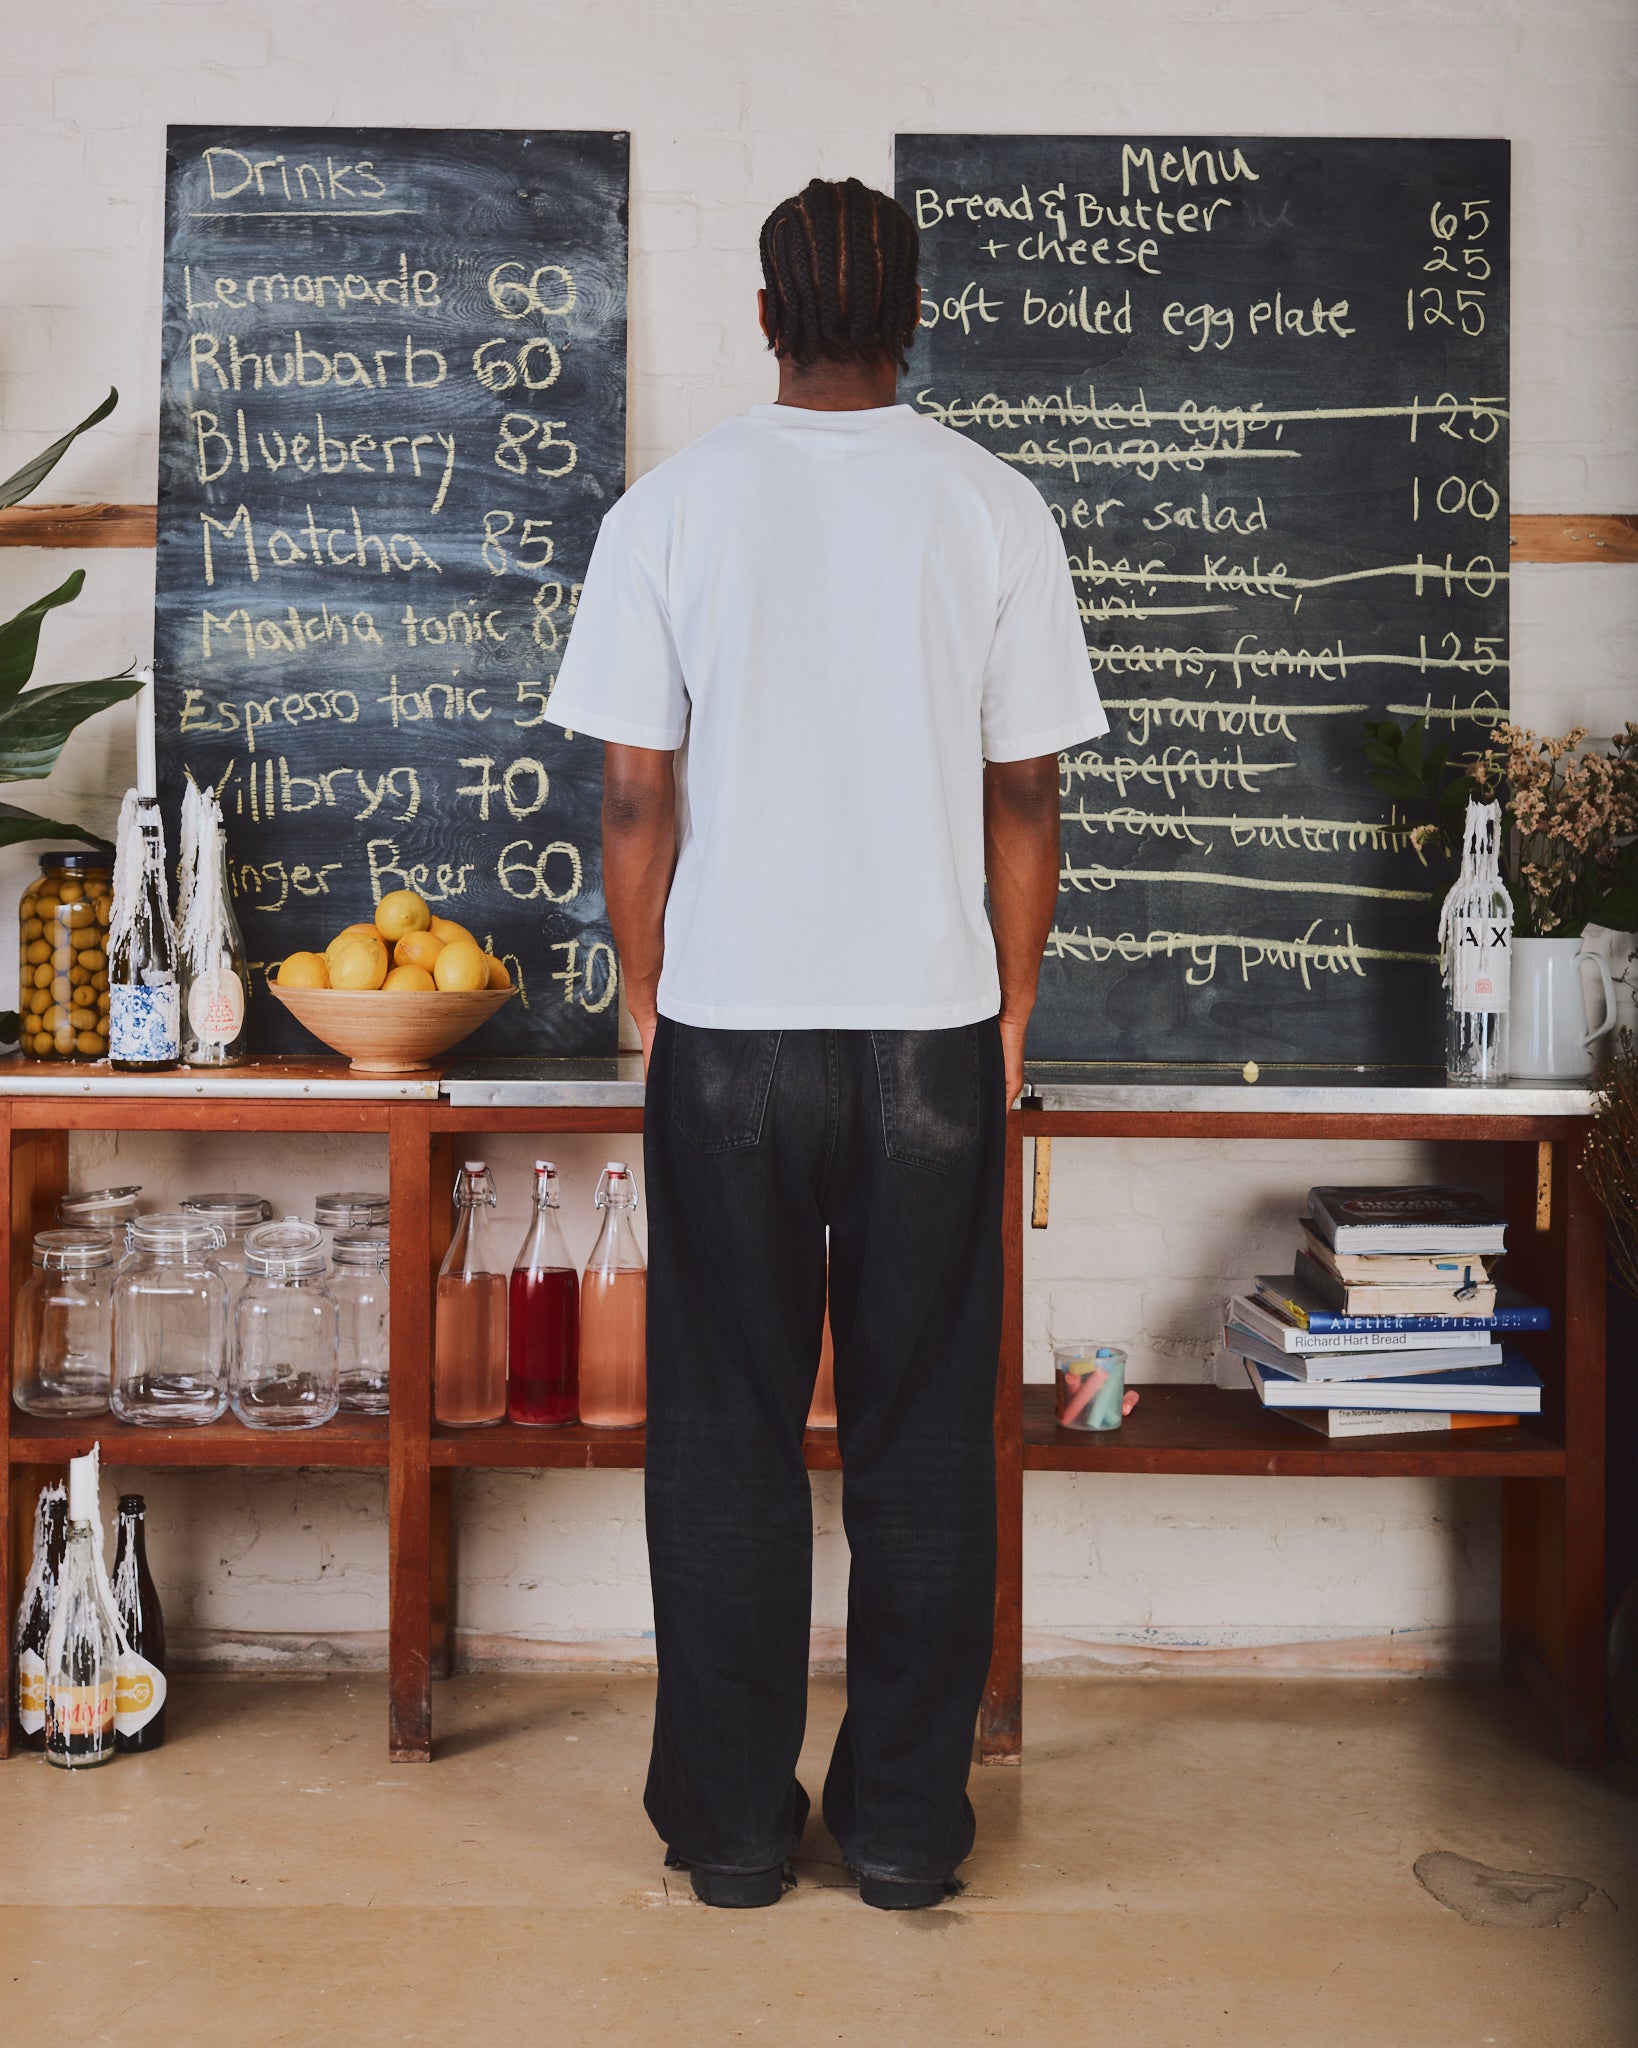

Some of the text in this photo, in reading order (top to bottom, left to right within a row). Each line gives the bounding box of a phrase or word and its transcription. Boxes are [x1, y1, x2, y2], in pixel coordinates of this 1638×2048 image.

[203, 147, 387, 201] Drinks
[1122, 143, 1260, 196] Menu
[915, 184, 1035, 229] Bread
[1073, 192, 1231, 235] Butter
[1430, 200, 1491, 240] 65
[184, 252, 577, 319] Lemonade 60
[1017, 231, 1161, 275] cheese
[1423, 246, 1491, 280] 25
[919, 281, 1486, 352] Soft boiled egg plate 125
[189, 331, 562, 391] Rhubarb 60
[1410, 392, 1507, 444] 125
[191, 408, 578, 514] Blueberry 85
[1142, 493, 1268, 535] salad
[1412, 475, 1500, 522] 100
[201, 504, 554, 585] Matcha 85
[1414, 553, 1497, 598] 110
[203, 603, 384, 659] Matcha
[401, 599, 508, 647] tonic
[1232, 634, 1348, 689] fennel
[1419, 631, 1505, 675] 125
[180, 688, 360, 753] Espresso
[377, 670, 493, 728] tonic
[1423, 690, 1499, 732] 110
[456, 754, 550, 822] 70
[176, 838, 583, 911] inger Beer 60
[550, 938, 618, 1014] 70
[1295, 1335, 1341, 1348] Richard
[1343, 1335, 1369, 1346] Hart
[1372, 1333, 1407, 1345] Bread
[1330, 1316, 1403, 1329] ATELIER
